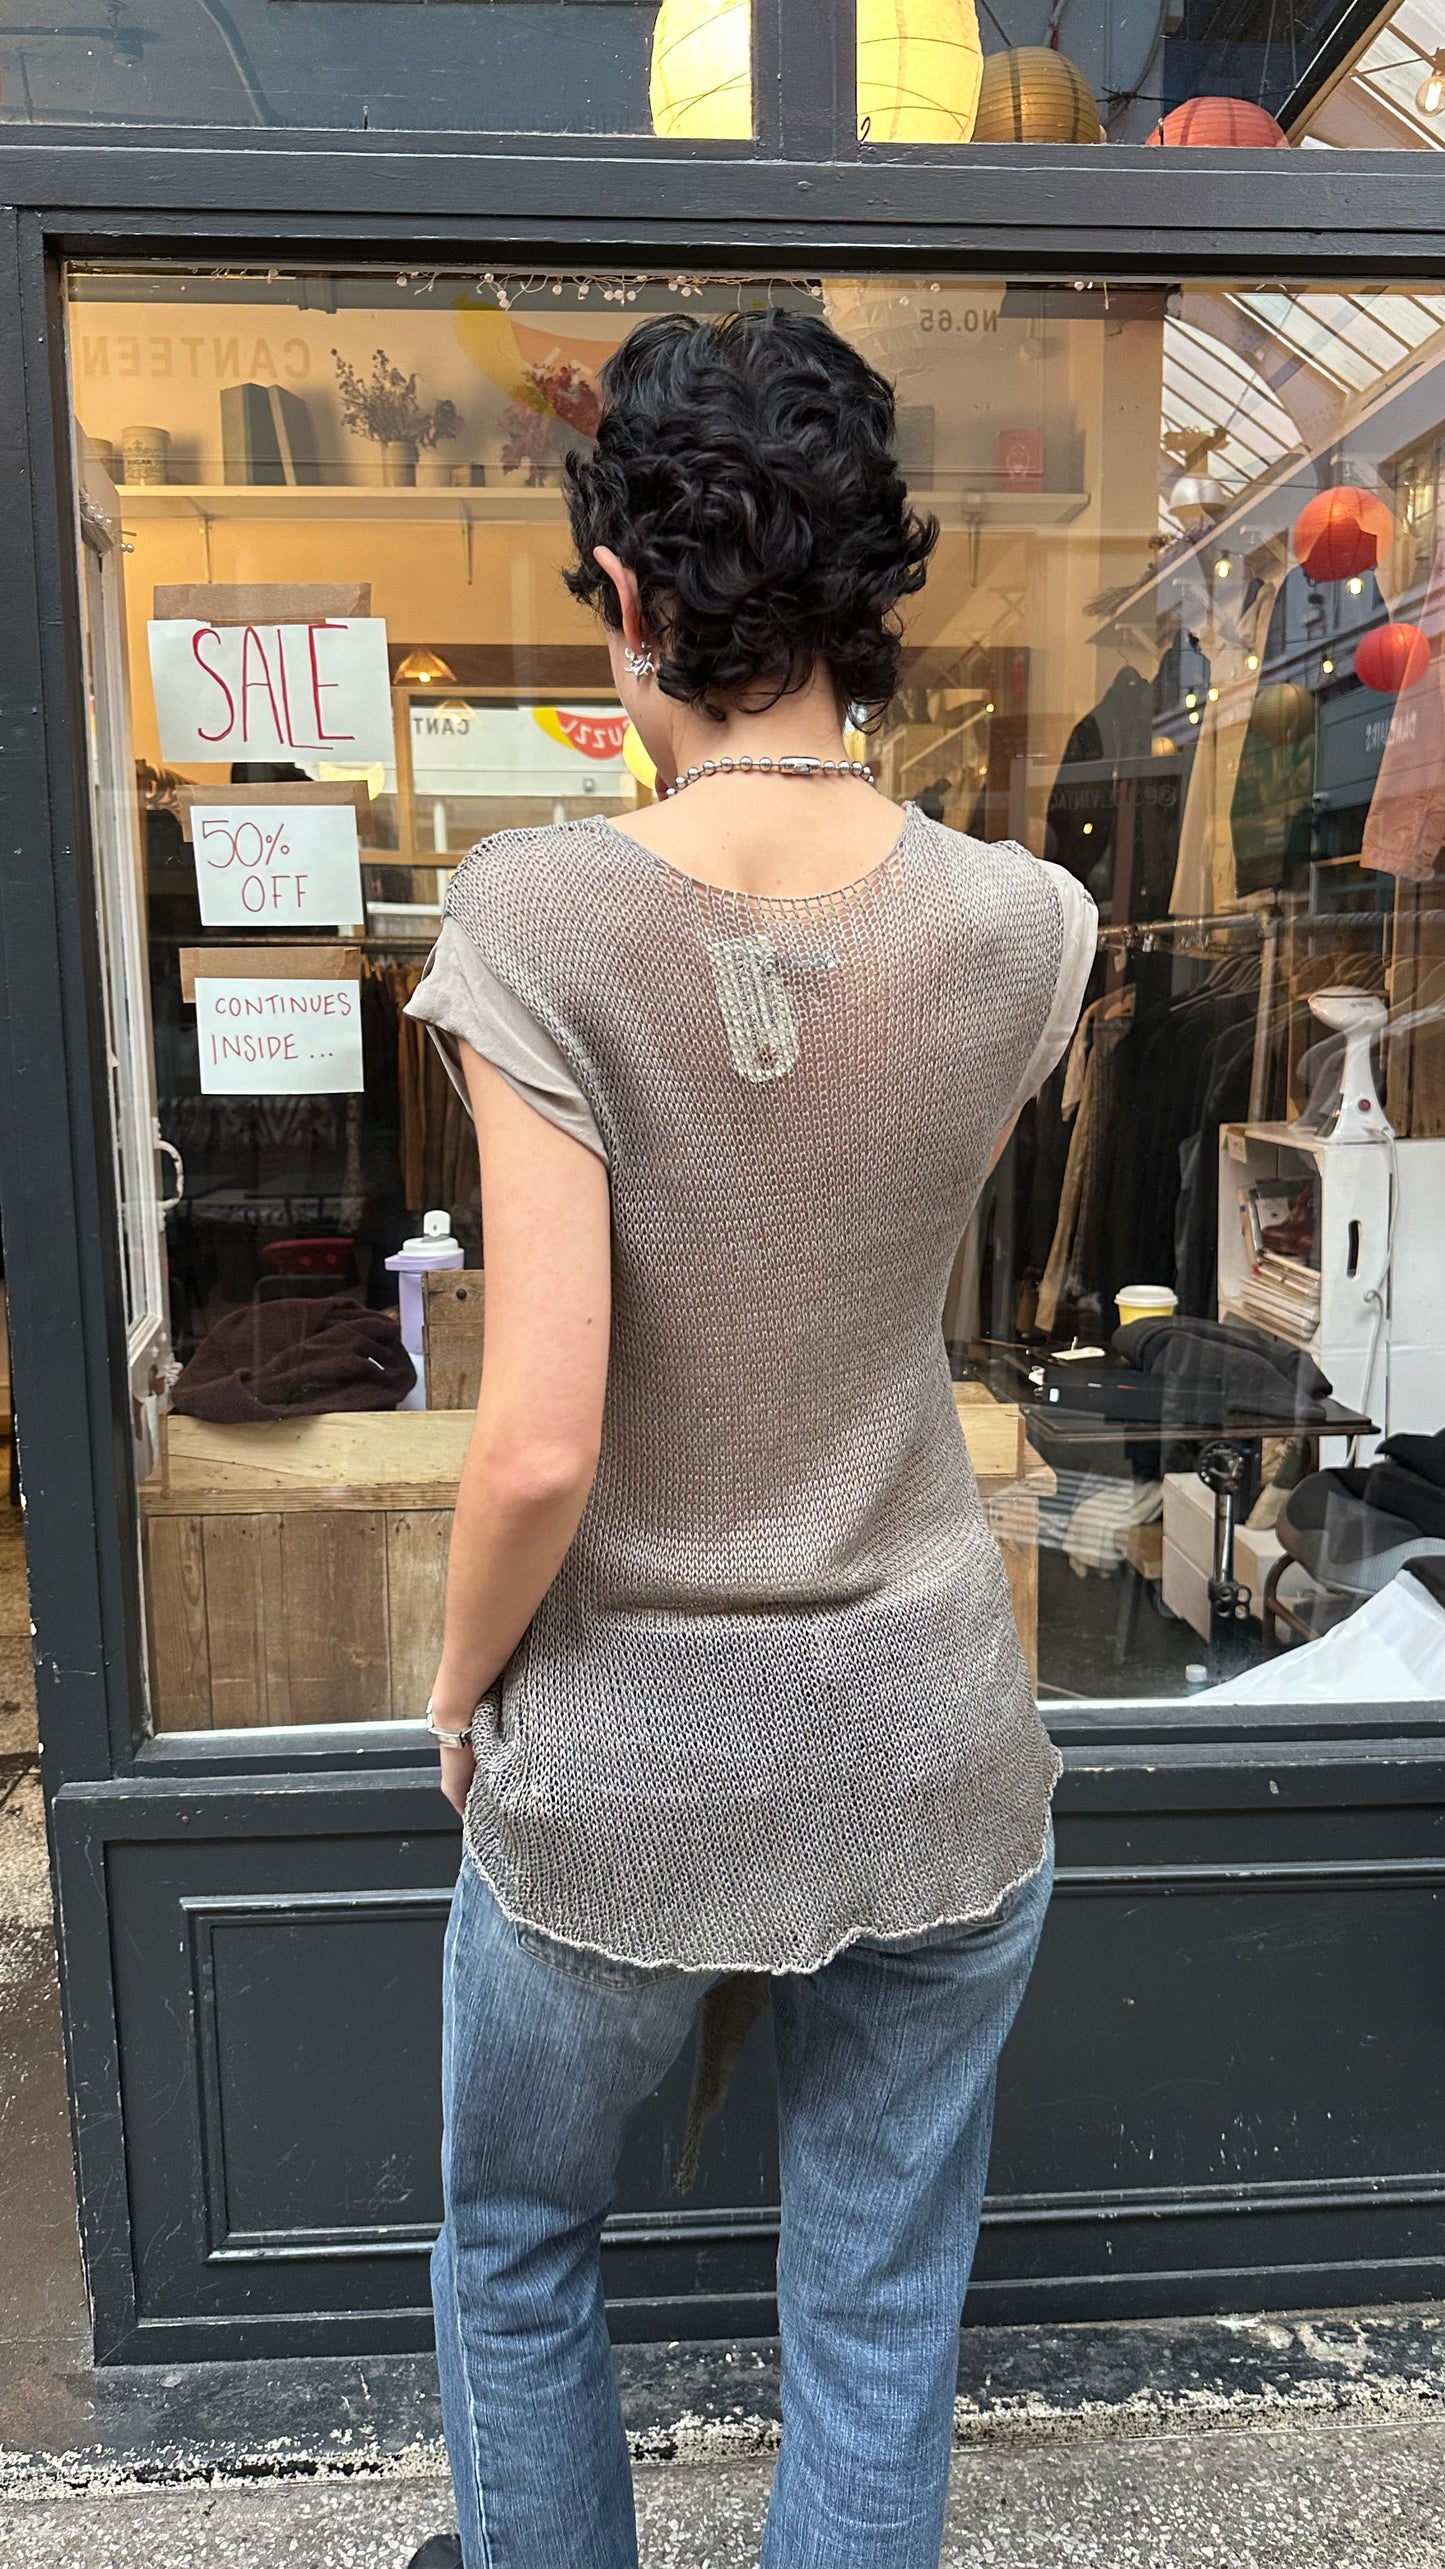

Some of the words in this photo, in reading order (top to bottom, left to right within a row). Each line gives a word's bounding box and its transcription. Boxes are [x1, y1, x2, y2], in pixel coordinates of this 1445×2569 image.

[192, 624, 355, 750] SALE
[201, 820, 290, 869] 50%
[241, 874, 308, 913] OFF
[215, 992, 352, 1017] CONTINUES
